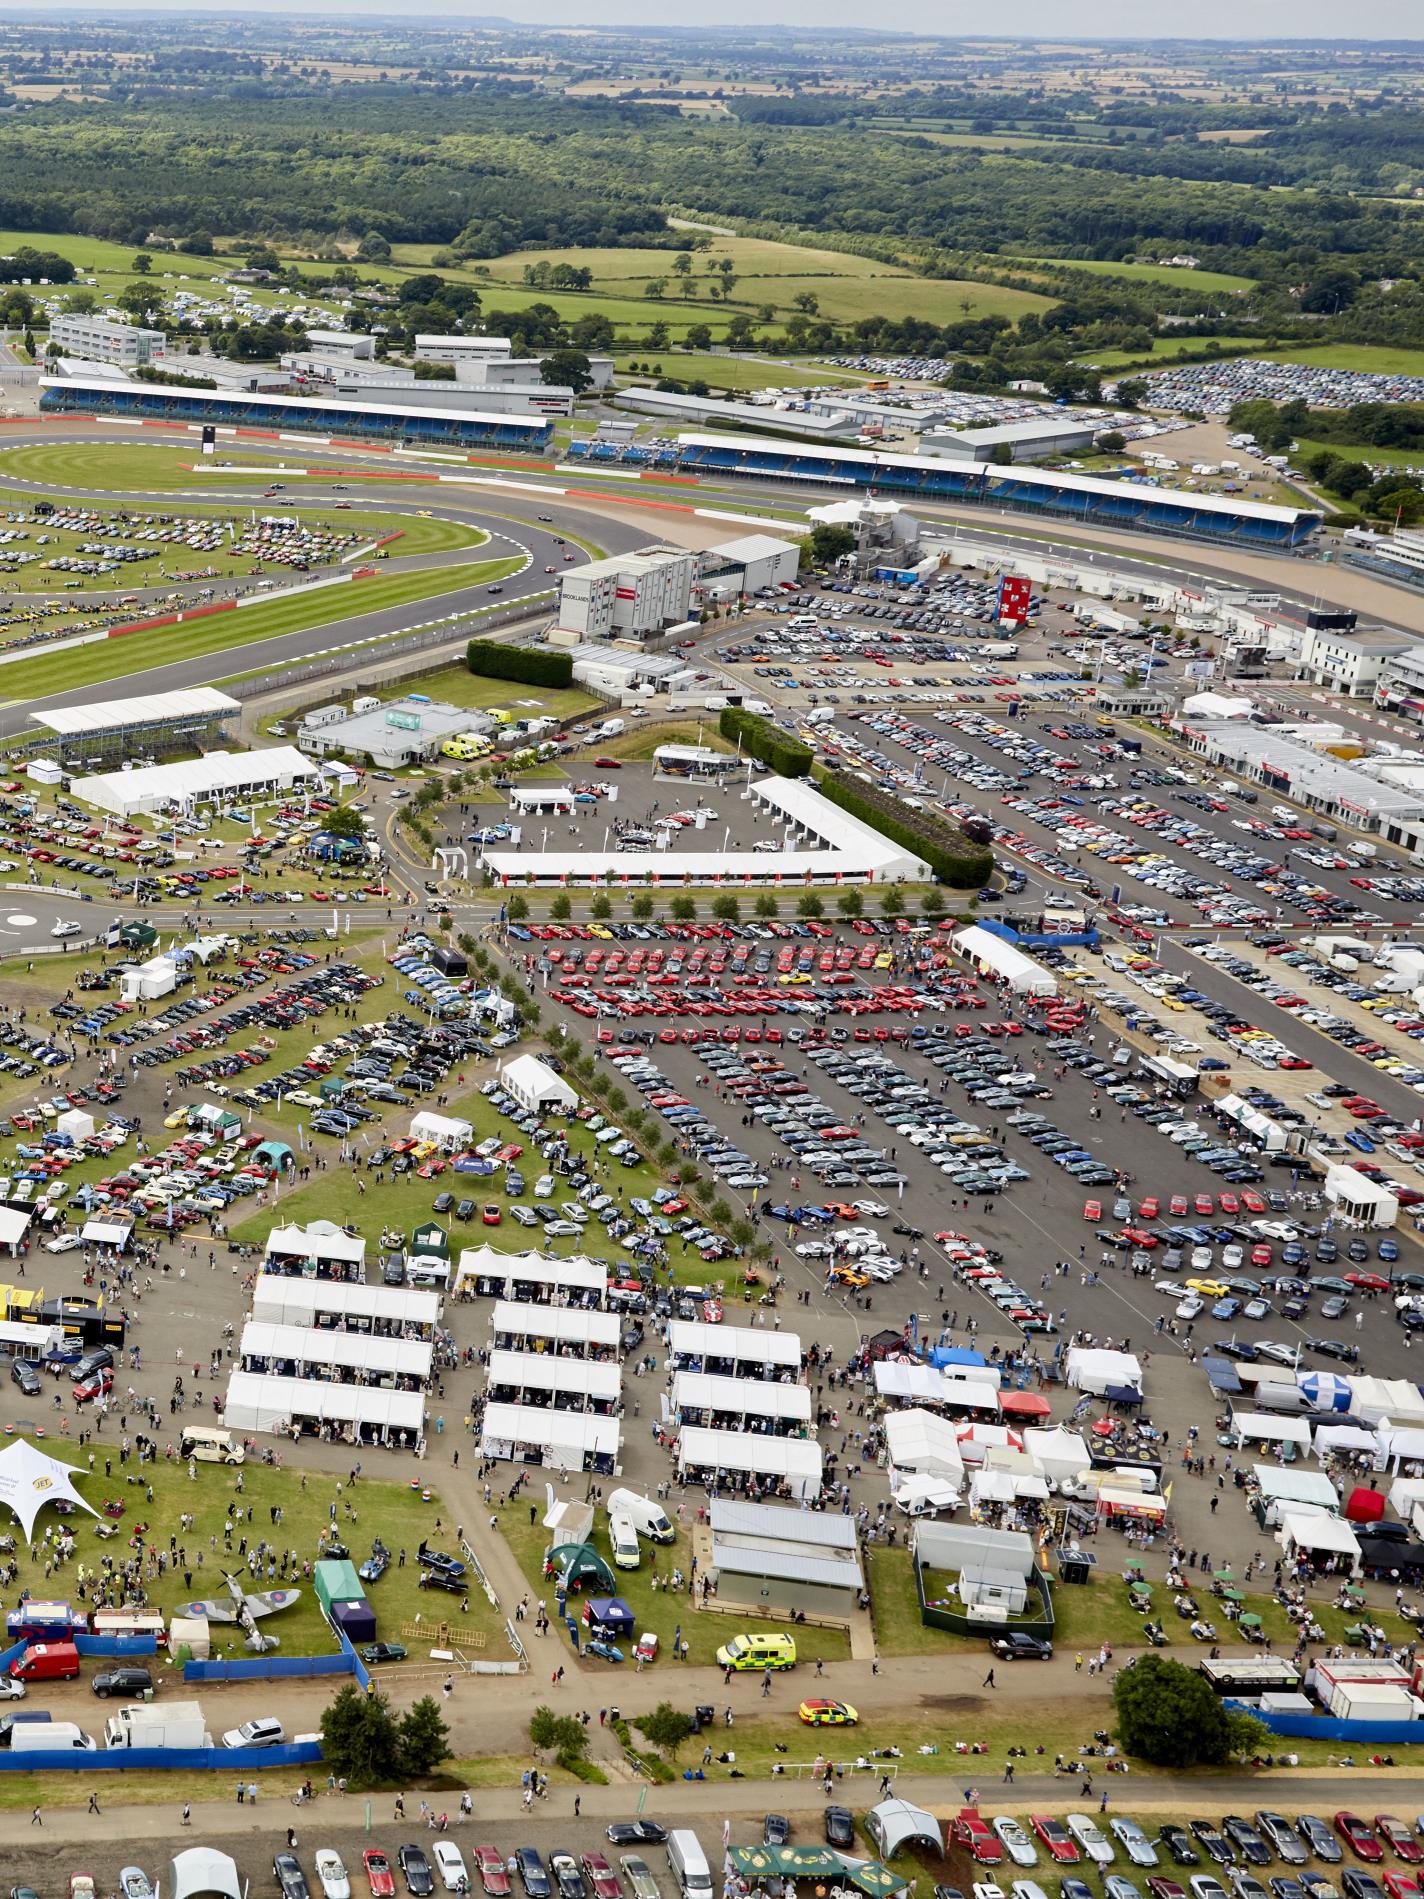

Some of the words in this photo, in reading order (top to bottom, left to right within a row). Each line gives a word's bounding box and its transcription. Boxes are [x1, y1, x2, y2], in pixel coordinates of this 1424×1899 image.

[563, 593, 589, 601] BROOKLANDS
[301, 732, 317, 740] MEDICAL
[318, 735, 334, 743] CENTRE
[35, 1478, 50, 1489] JET
